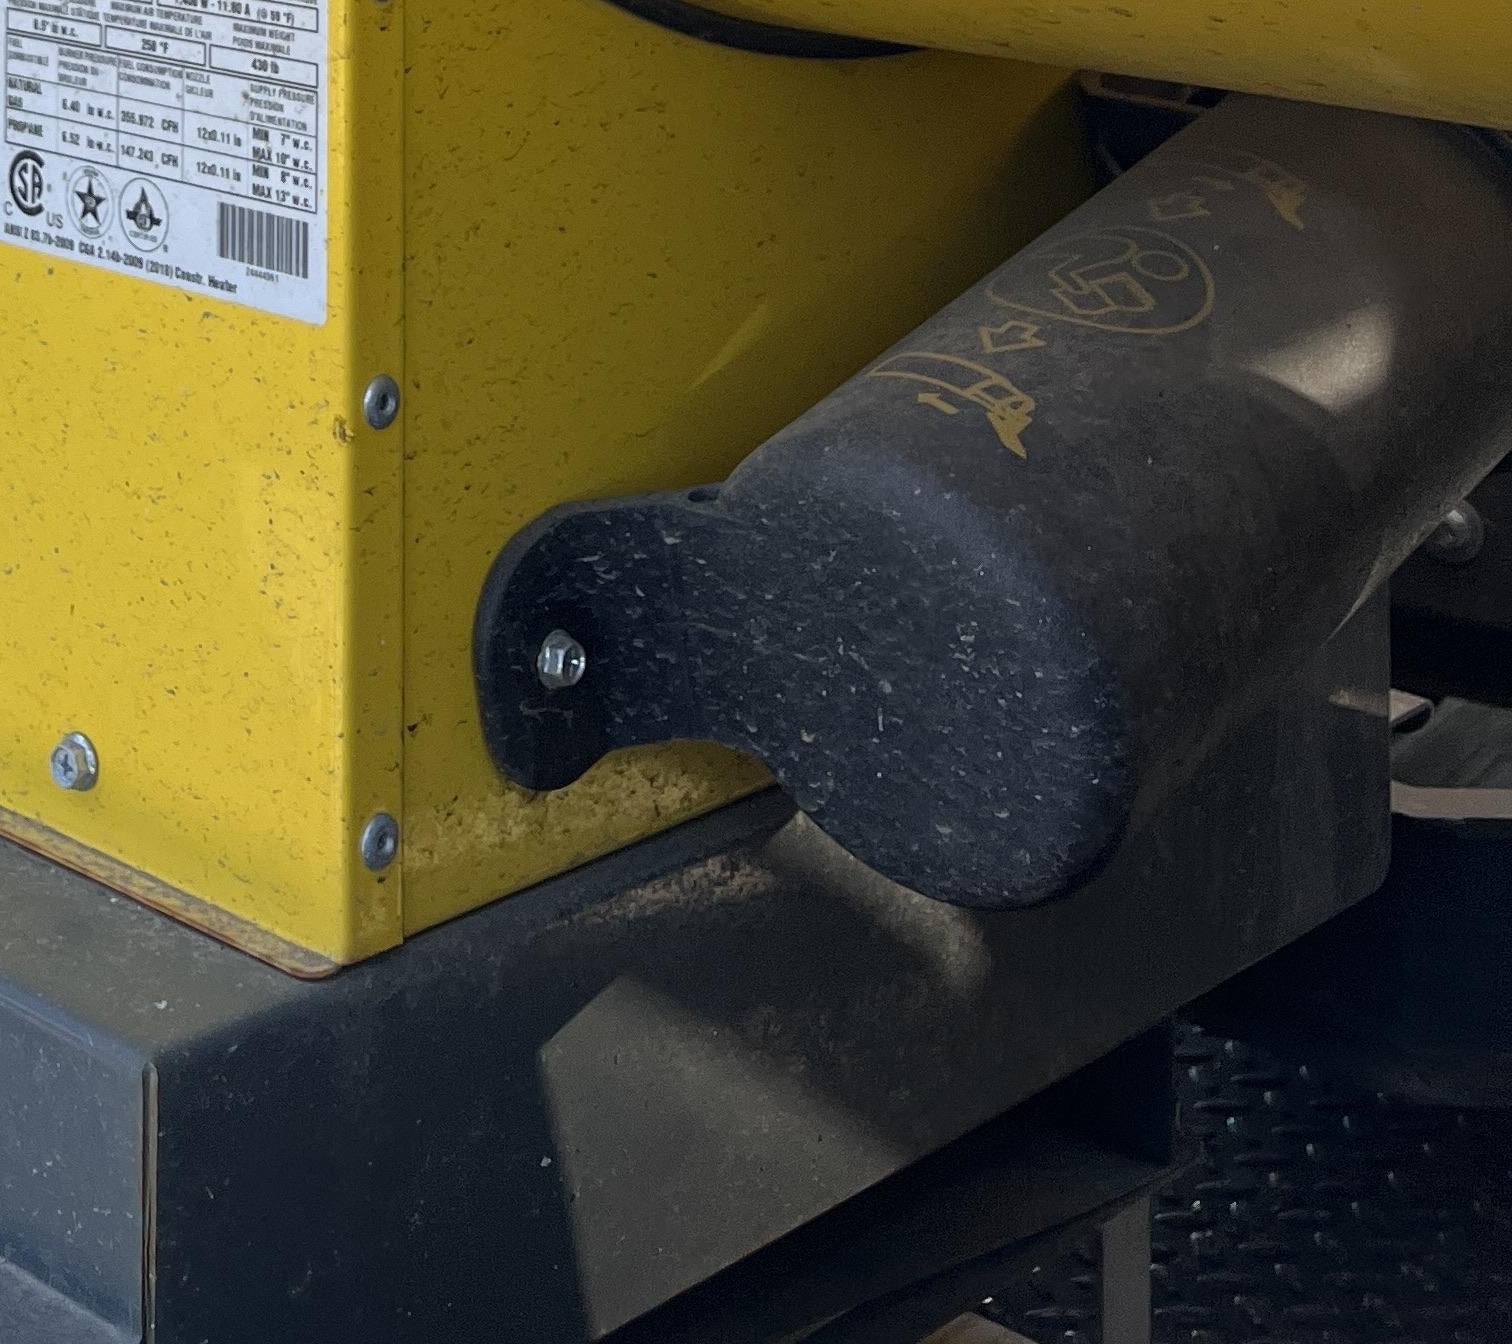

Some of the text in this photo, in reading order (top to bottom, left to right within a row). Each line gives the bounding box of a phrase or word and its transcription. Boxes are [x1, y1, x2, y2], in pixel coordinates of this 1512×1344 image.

[252, 126, 269, 142] MIN
[252, 146, 272, 162] MAX
[252, 163, 269, 179] MIN
[252, 183, 272, 199] MAX
[45, 212, 63, 229] US
